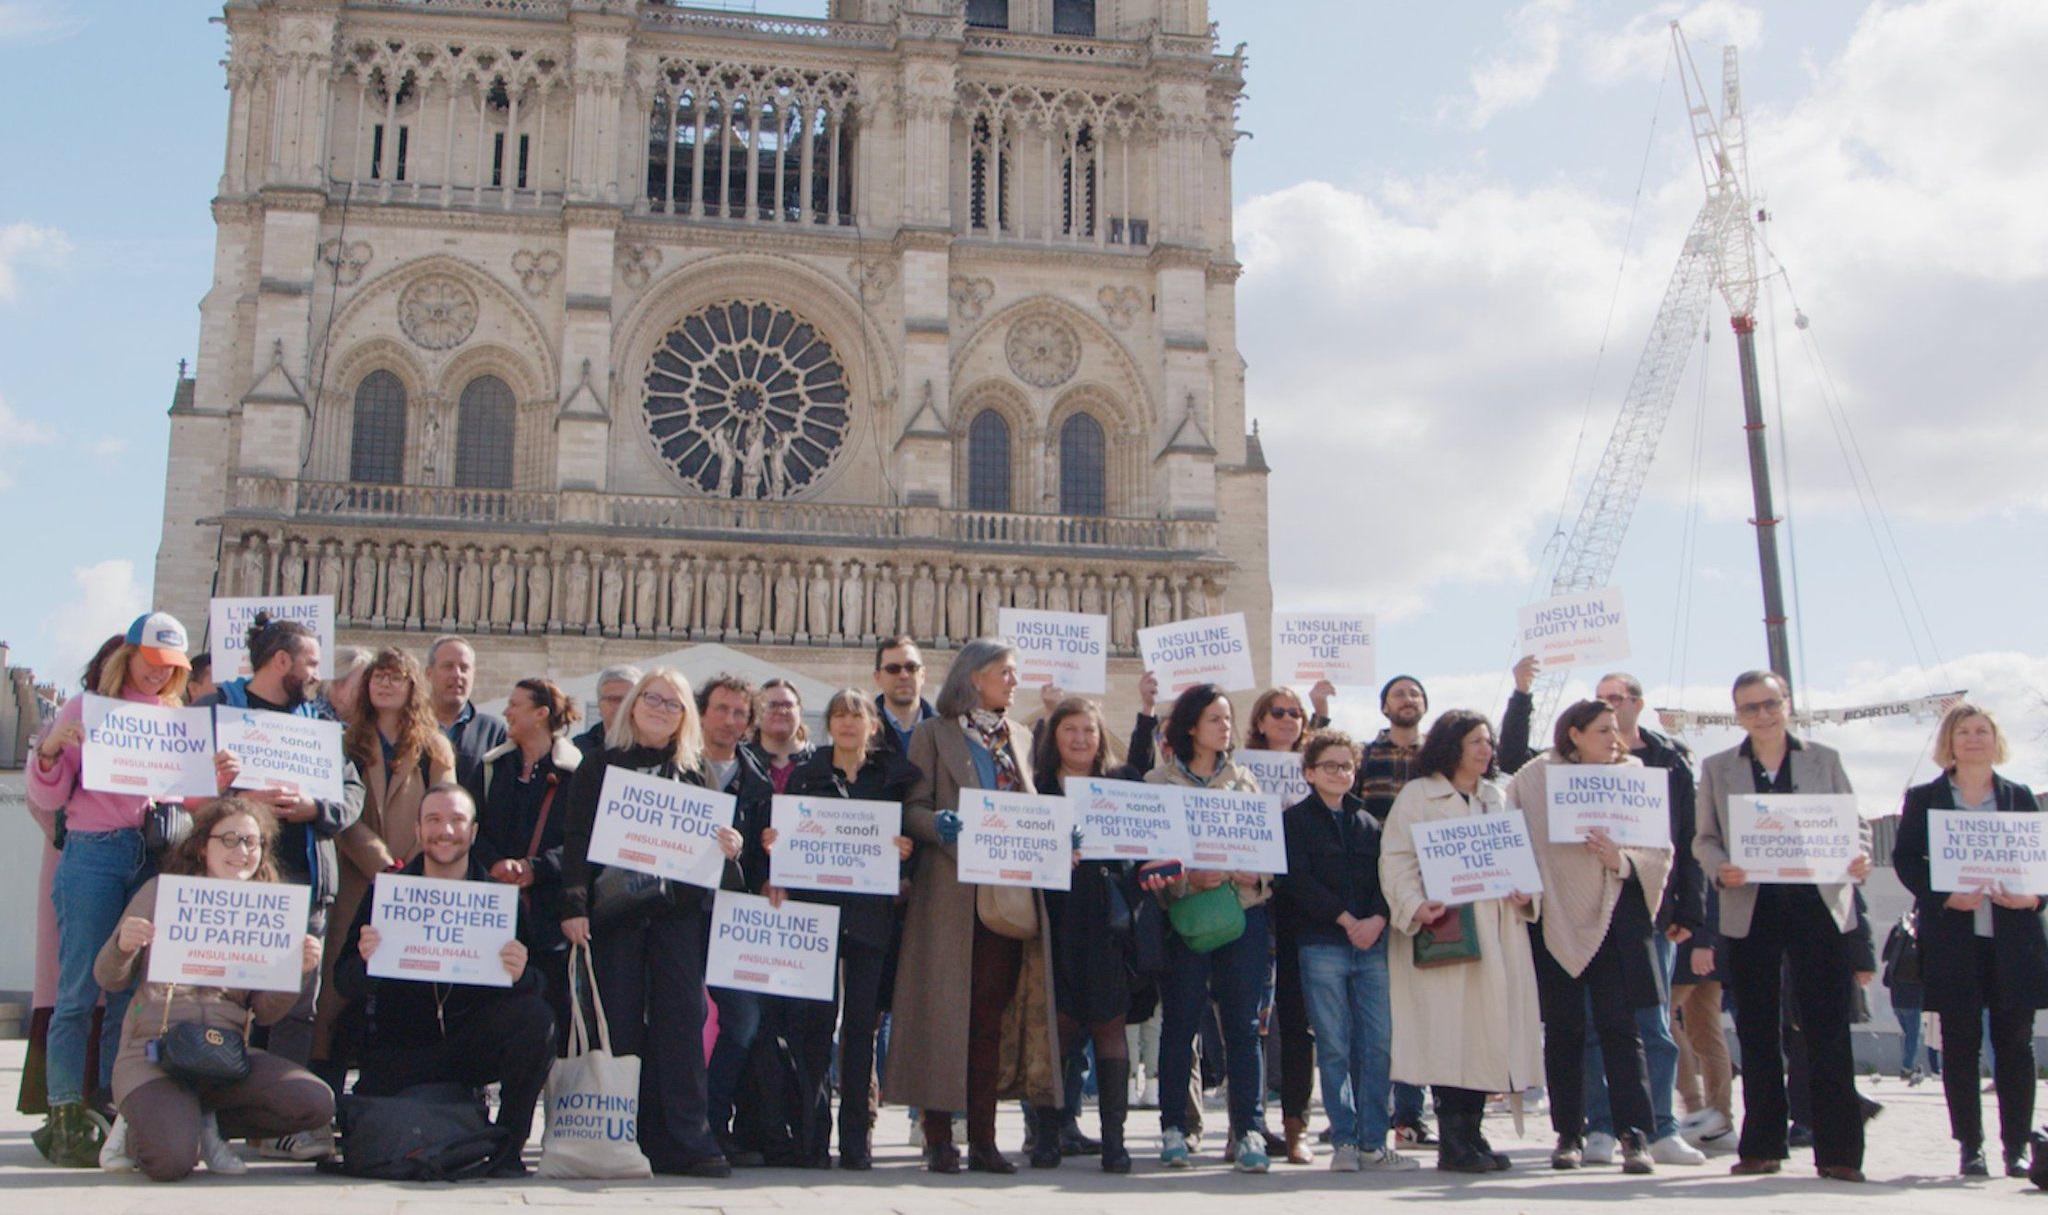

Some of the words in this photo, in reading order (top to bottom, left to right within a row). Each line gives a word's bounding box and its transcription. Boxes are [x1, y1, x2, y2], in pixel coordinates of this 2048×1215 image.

[1536, 600, 1604, 624] INSULIN
[1017, 622, 1090, 639] INSULINE
[1286, 621, 1362, 632] L'INSULINE
[1524, 620, 1577, 640] EQUITY
[1584, 612, 1620, 629] NOW
[1158, 627, 1230, 648] INSULINE
[1279, 634, 1318, 645] TROP
[1058, 639, 1100, 655] TOUS
[1151, 646, 1195, 664] POUR
[1201, 640, 1242, 657] TOUS
[1311, 646, 1339, 658] TUE
[106, 713, 186, 737] INSULIN
[90, 729, 154, 751] EQUITY
[161, 739, 206, 753] NOW
[280, 736, 321, 750] sanofi
[228, 743, 332, 768] RESPONSABLES
[253, 757, 330, 779] COUPABLES
[1284, 781, 1307, 794] NO
[1569, 777, 1645, 793] INSULIN
[623, 786, 713, 820] INSULINE
[1126, 802, 1166, 813] sanofi
[1183, 794, 1267, 814] L'INSULINE
[1554, 792, 1616, 805] EQUITY
[1622, 794, 1662, 808] NOW
[607, 801, 663, 826] POUR
[670, 814, 720, 840] TOUS
[1017, 819, 1055, 831] sanofi
[1086, 814, 1171, 830] PROFITEURS
[1185, 809, 1230, 823] N'EST
[1236, 813, 1266, 827] PAS
[1794, 817, 1838, 829] sanofi
[1945, 819, 2042, 834] L'INSULINE
[835, 824, 879, 837] sanofi
[1101, 826, 1120, 836] DU
[1125, 828, 1158, 839] 100%
[1207, 825, 1273, 841] PARFUM
[1427, 820, 1512, 843] L'INSULINE
[625, 832, 694, 854] #INSULIN4ALL
[790, 839, 881, 856] PROFITEURS
[975, 834, 1057, 851] PROFITEURS
[1740, 835, 1850, 846] RESPONSABLES
[1949, 833, 1998, 847] N'EST
[2006, 835, 2040, 848] PAS
[989, 848, 1006, 859] DU
[1012, 850, 1044, 862] 100%
[1422, 842, 1466, 859] TROP
[1744, 848, 1760, 857] ET
[1765, 847, 1848, 858] COUPABLES
[1943, 847, 1966, 859] DU
[1973, 849, 2048, 862] PARFUM
[805, 853, 825, 864] DU
[831, 854, 866, 868] 100%
[1461, 853, 1495, 869] TUE
[178, 888, 290, 911] L'INSULINE
[394, 887, 499, 910] L'INSULINE
[178, 907, 239, 926] N'EST
[246, 912, 285, 929] PAS
[382, 904, 435, 922] TROP
[441, 908, 508, 928] CHÈRE
[733, 908, 818, 934] INSULINE
[169, 925, 197, 942] DU
[205, 928, 291, 949] PARFUM
[423, 925, 464, 943] TUE
[719, 924, 771, 945] POUR
[778, 932, 829, 952] TOUS
[187, 949, 268, 964] #INSULIN4ALL
[404, 945, 480, 959] #INSULIN4ALL
[739, 953, 805, 970] #INSULIN4ALL
[555, 1115, 604, 1127] ABOUT
[553, 1129, 603, 1139] WITHOUT
[607, 1118, 634, 1142] US
